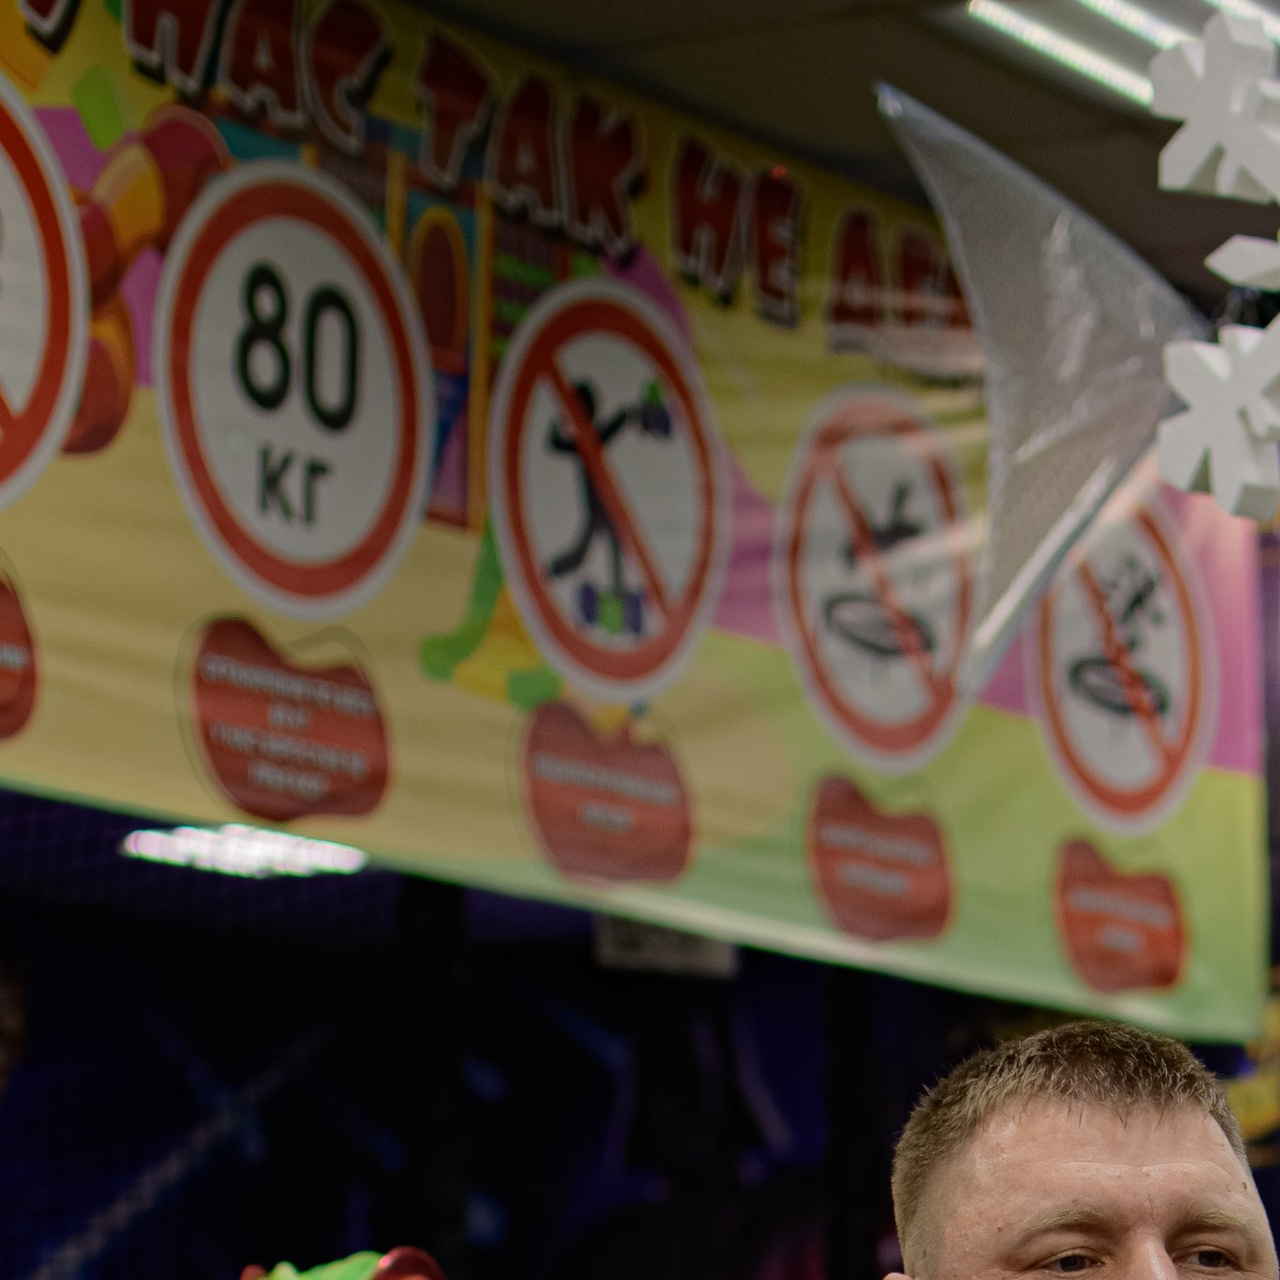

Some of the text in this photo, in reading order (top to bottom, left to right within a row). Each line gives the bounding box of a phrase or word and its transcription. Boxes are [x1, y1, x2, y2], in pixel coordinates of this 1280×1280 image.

[418, 32, 646, 264] ТАК
[668, 130, 803, 327] НЕ
[237, 262, 360, 431] 80
